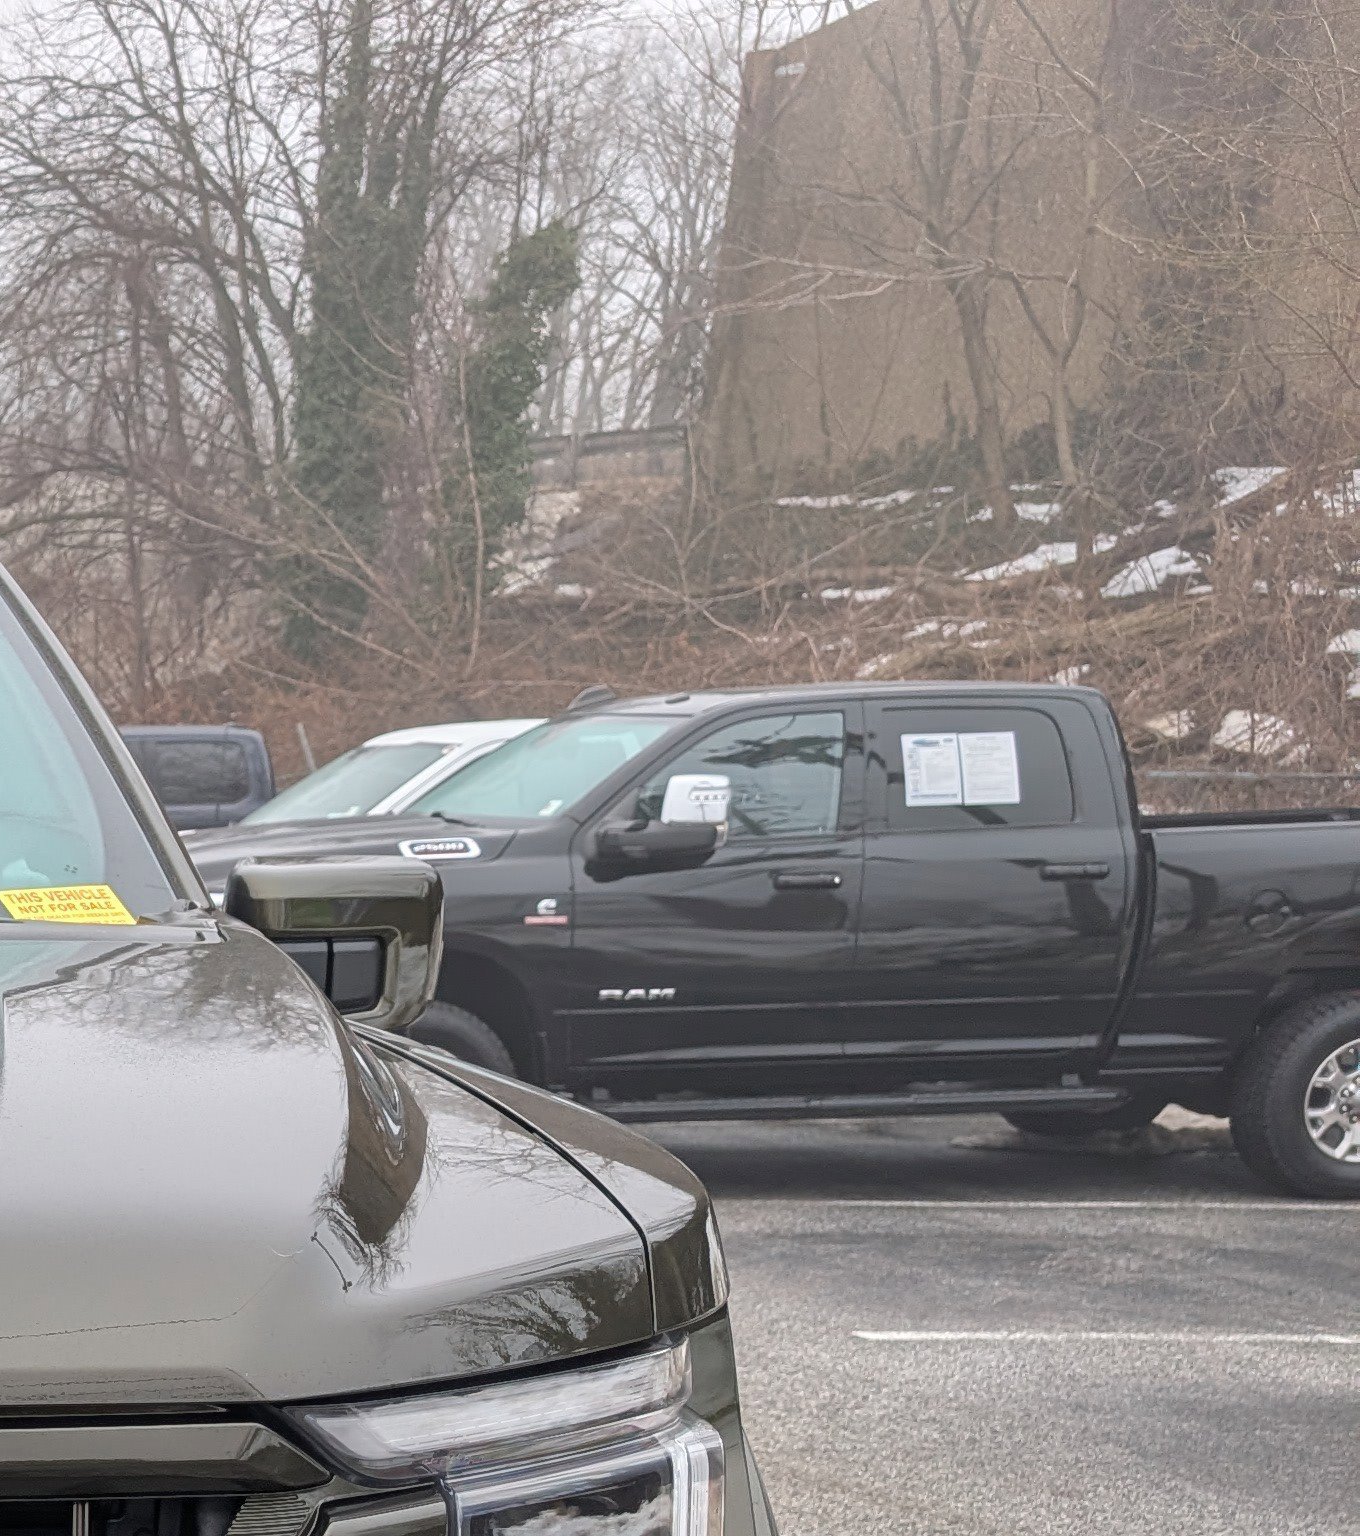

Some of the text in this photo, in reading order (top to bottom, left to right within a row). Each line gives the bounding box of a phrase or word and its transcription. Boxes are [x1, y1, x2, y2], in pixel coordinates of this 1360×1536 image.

[4, 888, 112, 905] THIS VEHICLE
[17, 901, 116, 915] NOT FOR SALE
[598, 987, 677, 1001] RAM
